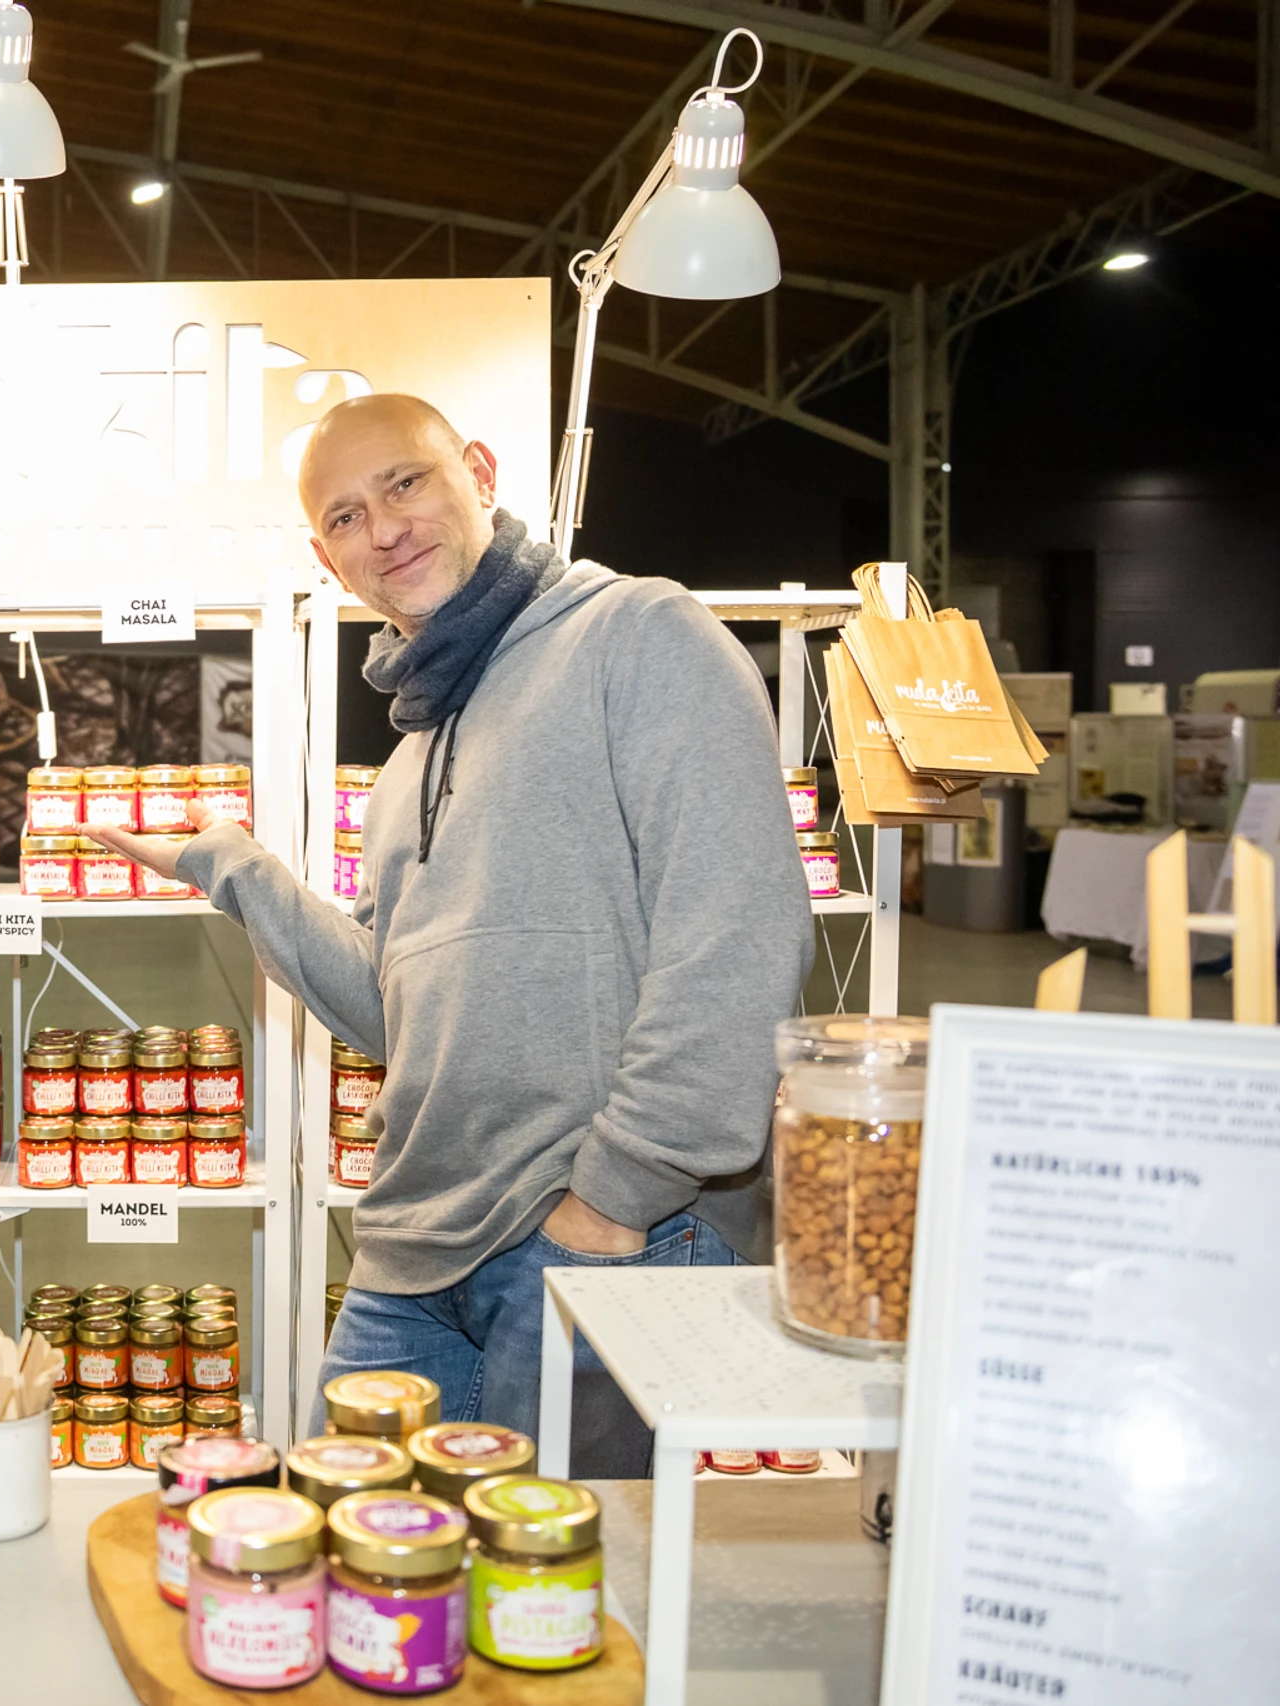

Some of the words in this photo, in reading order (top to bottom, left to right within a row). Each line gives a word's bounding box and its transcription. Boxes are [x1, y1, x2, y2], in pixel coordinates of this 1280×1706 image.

[131, 599, 166, 610] CHAI
[121, 613, 177, 625] MASALA
[866, 719, 889, 735] ru
[6, 914, 35, 925] KITA
[100, 1203, 168, 1215] MANDEL
[120, 1218, 147, 1226] 100%
